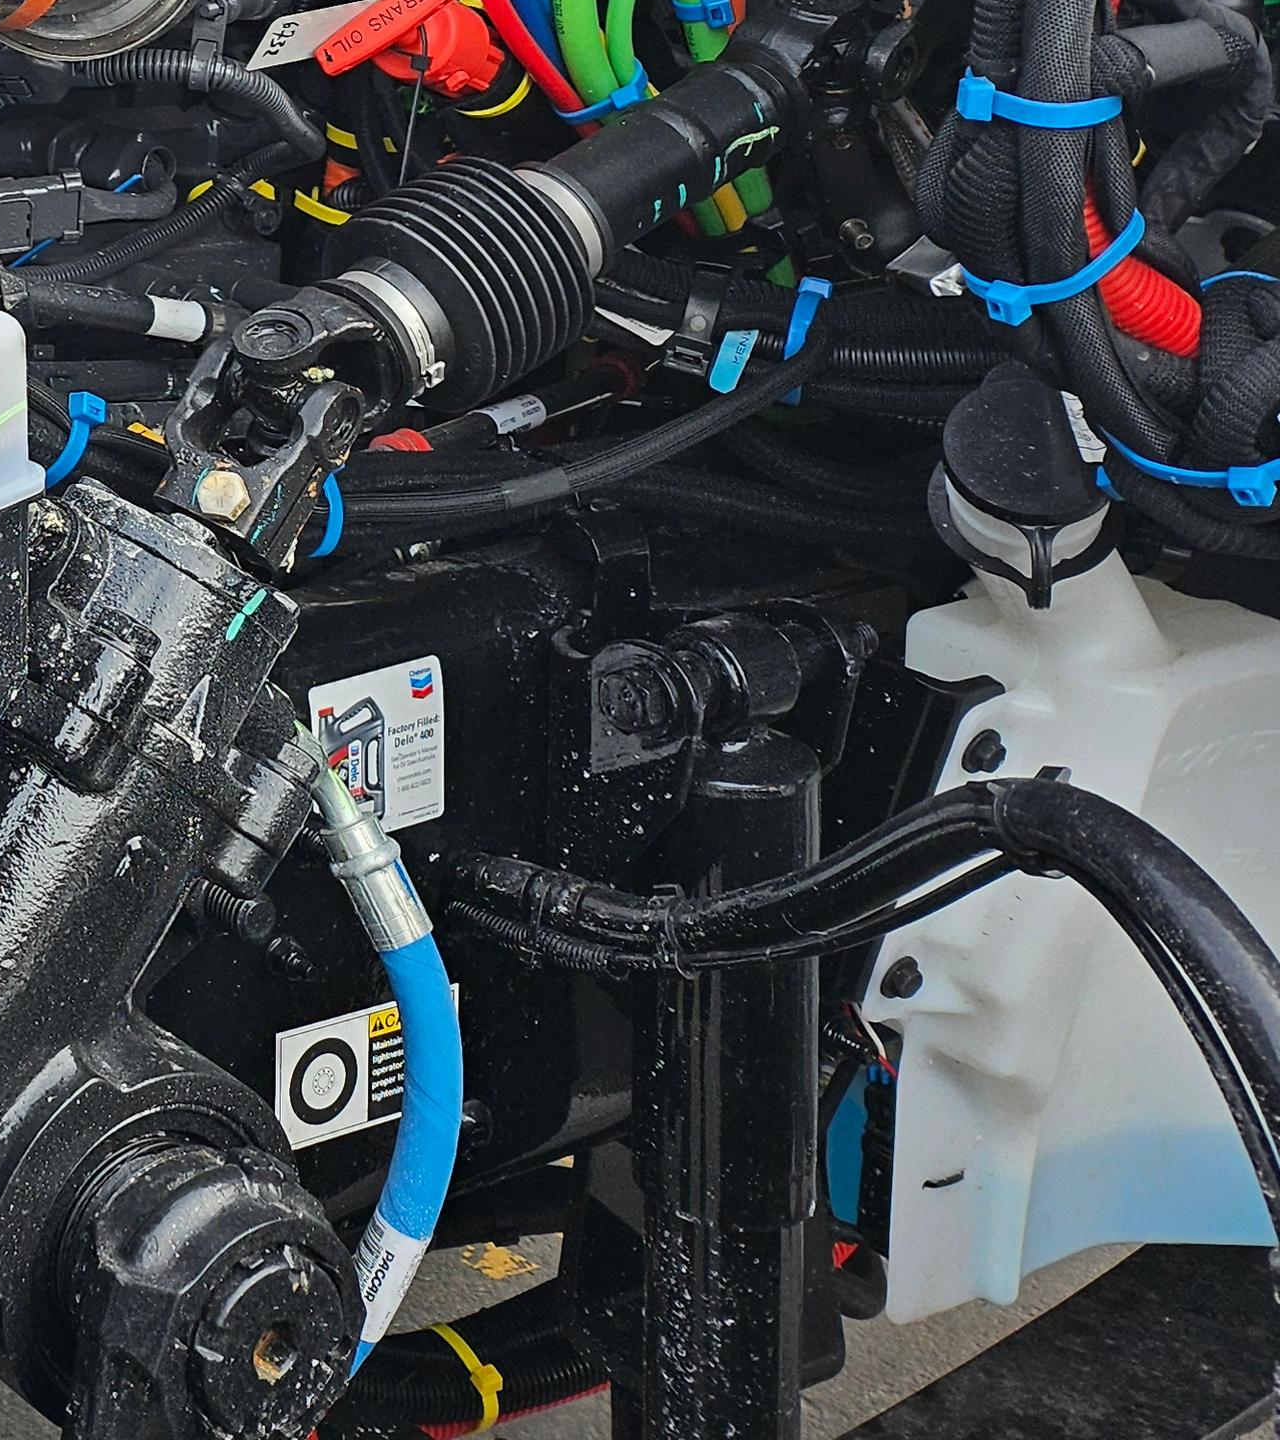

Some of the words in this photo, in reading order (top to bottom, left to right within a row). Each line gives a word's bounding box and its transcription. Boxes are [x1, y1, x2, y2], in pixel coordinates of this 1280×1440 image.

[333, 30, 363, 53] OIL
[388, 722, 415, 736] Factory
[417, 714, 440, 728] Filled:
[420, 728, 433, 739] 400
[364, 1251, 395, 1303] PACCAR
